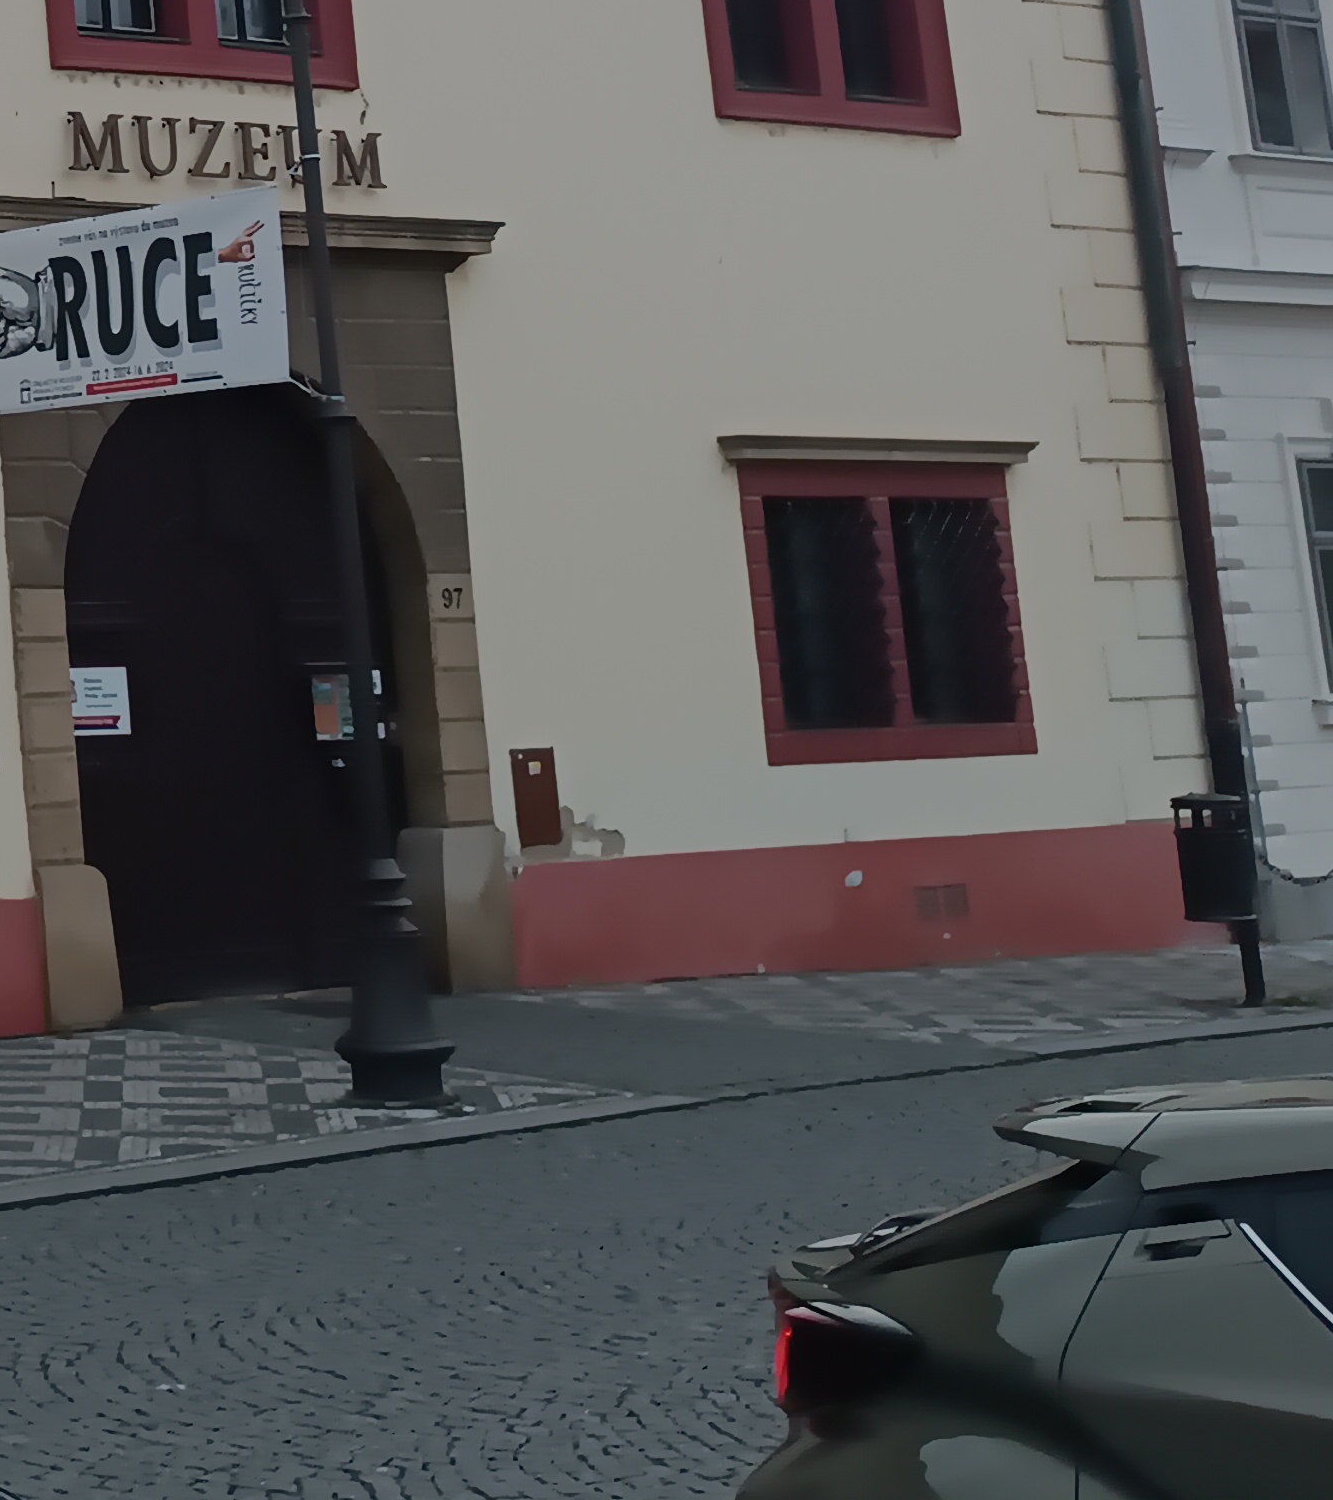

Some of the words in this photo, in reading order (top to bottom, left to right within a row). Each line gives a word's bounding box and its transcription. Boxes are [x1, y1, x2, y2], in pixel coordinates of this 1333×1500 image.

[67, 111, 387, 188] MUZEUM
[48, 232, 219, 362] RUCE
[441, 587, 463, 609] 97
